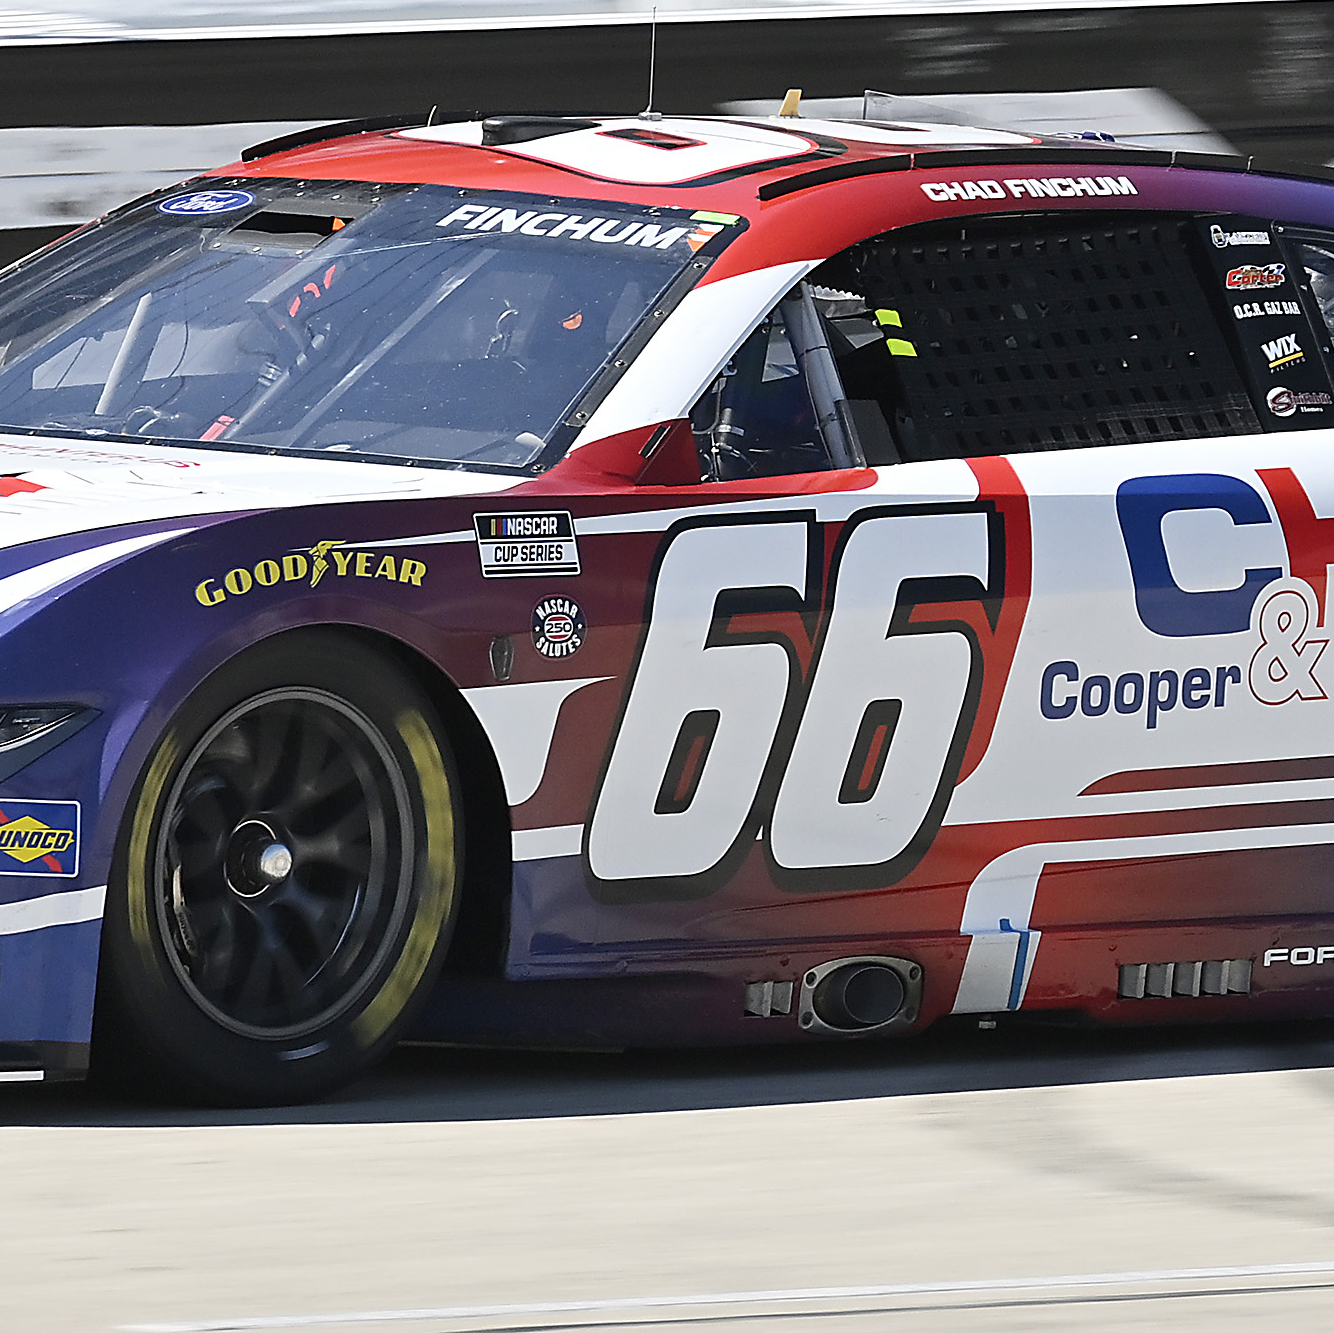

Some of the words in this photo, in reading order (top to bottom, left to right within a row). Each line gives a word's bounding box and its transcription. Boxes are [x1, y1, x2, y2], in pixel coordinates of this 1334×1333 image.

[920, 180, 1006, 201] CHAD
[1003, 176, 1138, 198] FINCHUM
[167, 192, 239, 212] Ford
[436, 204, 689, 249] FINCHUM
[1227, 269, 1283, 286] Carter
[1260, 333, 1302, 361] WIX
[507, 516, 558, 535] NASCAR
[494, 545, 518, 562] CUP
[520, 544, 563, 562] SERIES
[536, 598, 578, 620] NASCAR
[546, 622, 572, 634] 250
[536, 634, 581, 656] SALUTES
[1039, 660, 1242, 730] Cooper
[1249, 589, 1330, 705] &
[584, 504, 995, 886] 66
